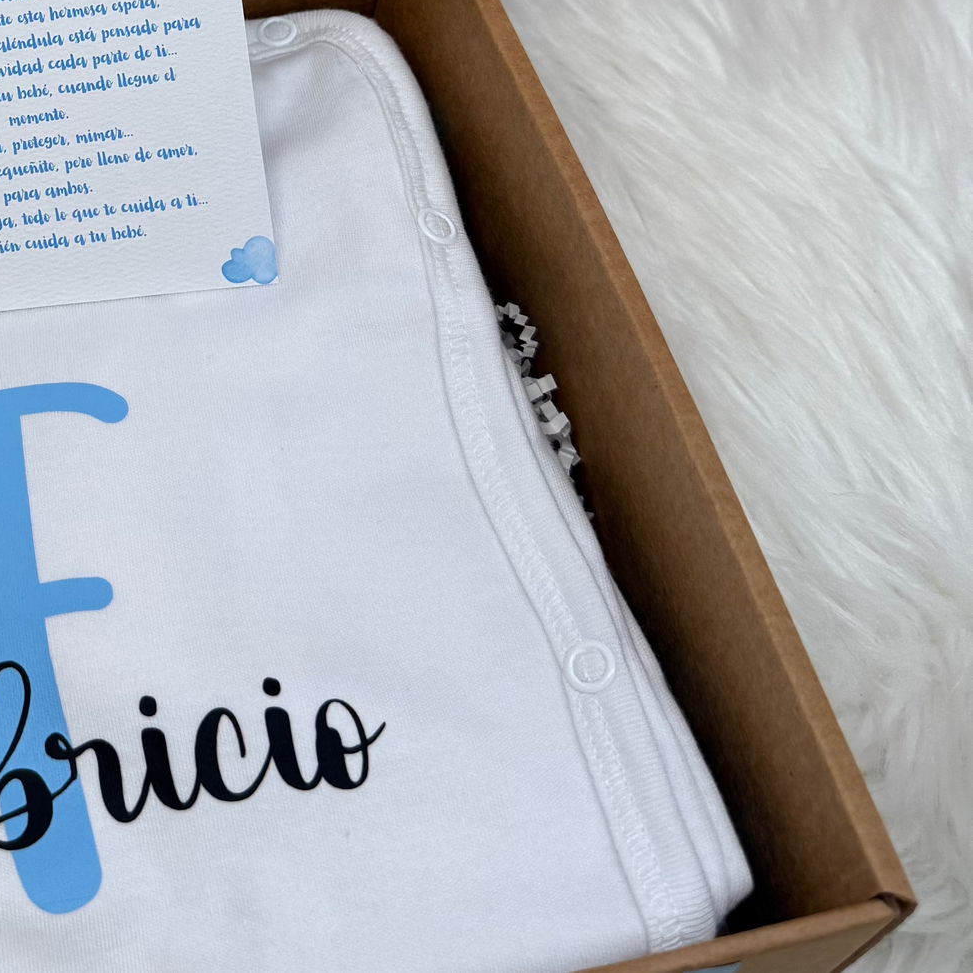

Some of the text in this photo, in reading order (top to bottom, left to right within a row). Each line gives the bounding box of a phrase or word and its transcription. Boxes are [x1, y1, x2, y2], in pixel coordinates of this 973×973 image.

[17, 11, 45, 24] esta
[49, 4, 107, 21] hermosa
[68, 29, 96, 44] está
[101, 20, 158, 43] pensado
[163, 16, 201, 35] para
[47, 55, 87, 71] cada
[92, 50, 130, 70] parte
[134, 46, 152, 61] de
[57, 77, 113, 94] cuando
[117, 72, 160, 88] llegue
[164, 67, 177, 82] el
[8, 108, 69, 127] momento.
[64, 157, 93, 174] pero
[97, 151, 130, 166] lleno
[134, 146, 153, 163] de
[3, 190, 41, 206] para
[22, 209, 51, 225] todo
[54, 209, 67, 222] lo
[72, 207, 100, 224] que
[103, 203, 117, 216] te
[121, 198, 166, 214] cuida
[170, 199, 183, 210] a
[24, 234, 69, 250] cuida
[73, 235, 86, 246] a
[90, 231, 107, 243] tu
